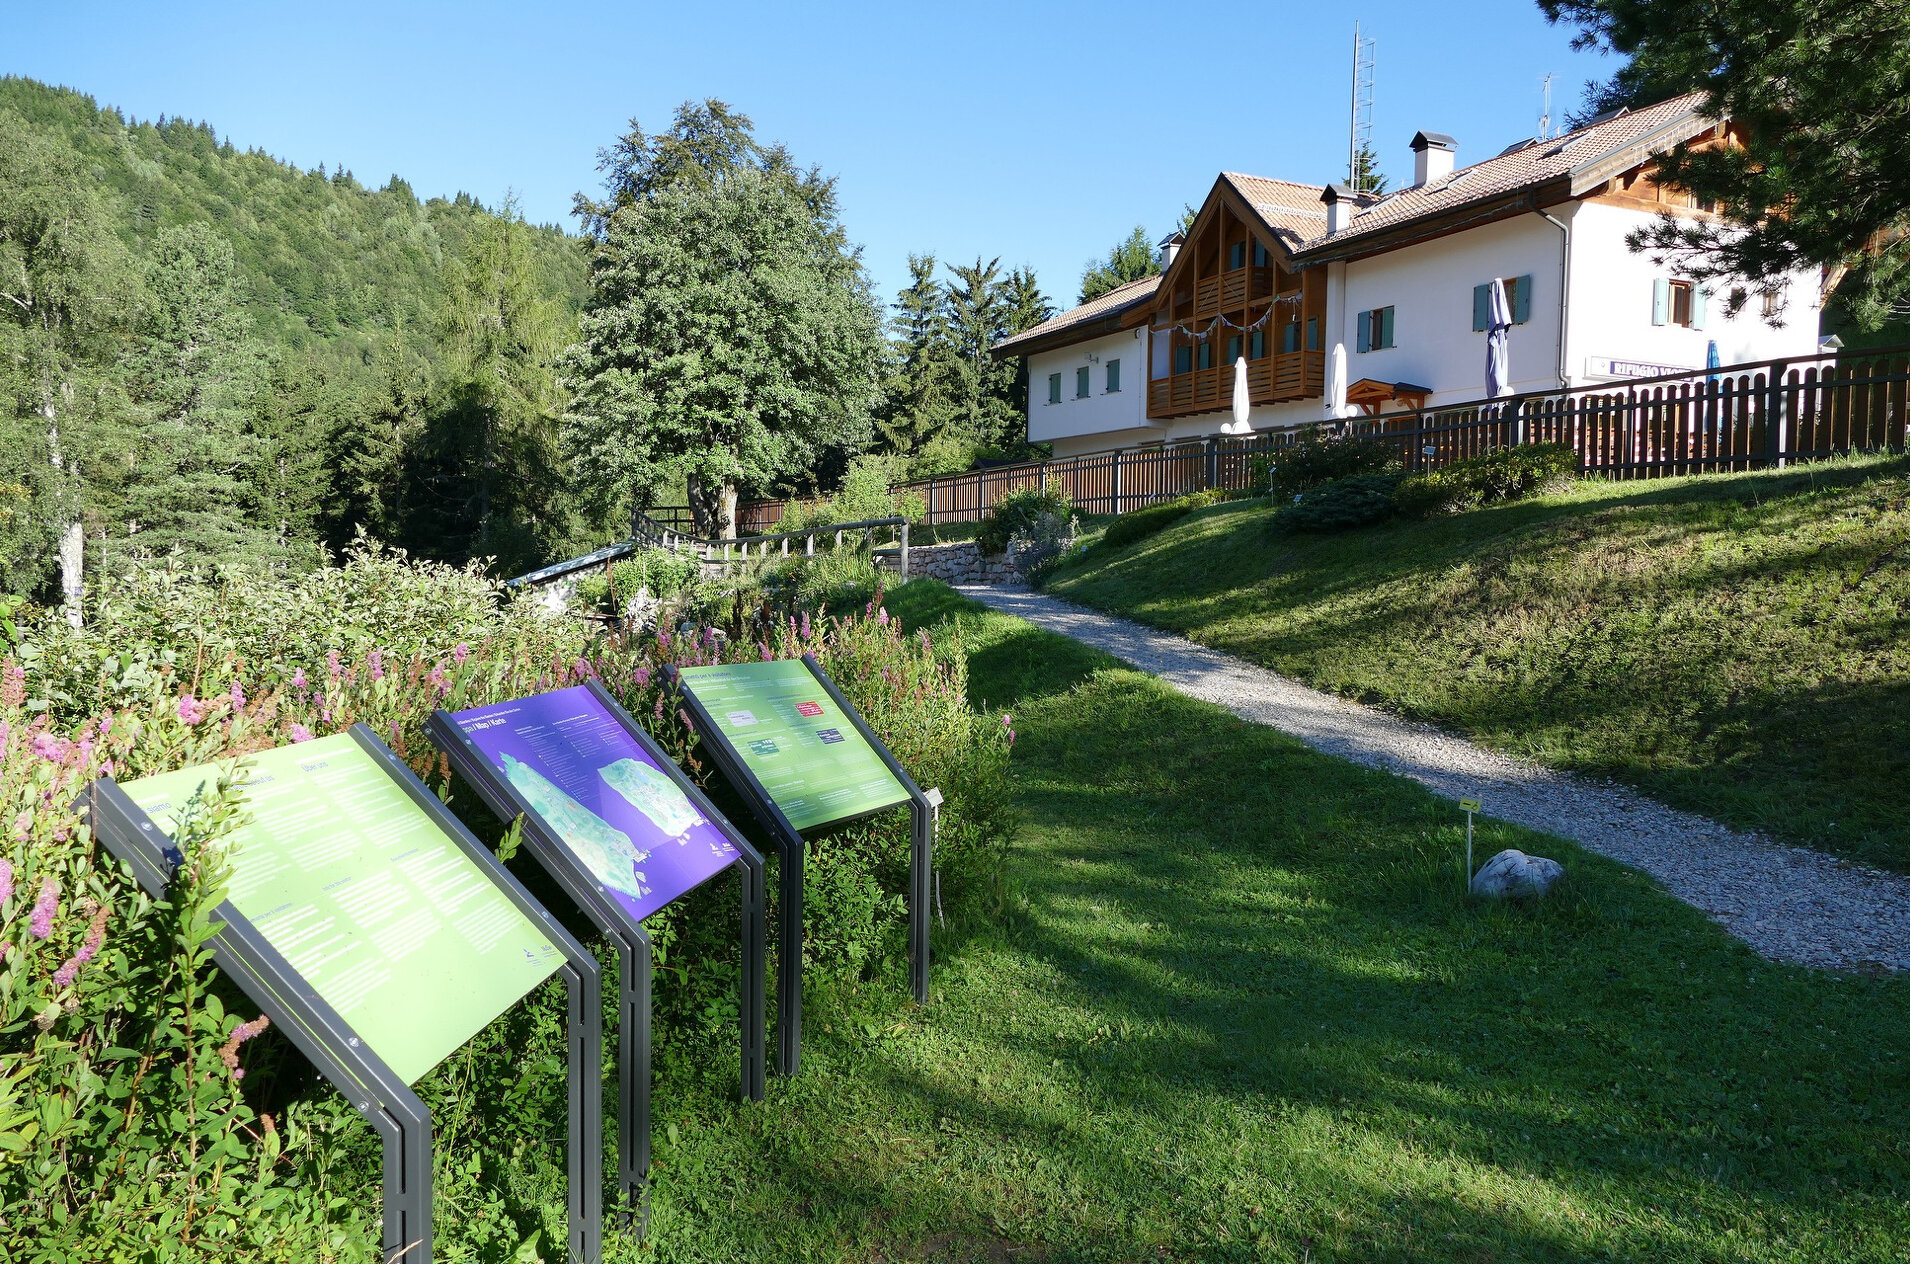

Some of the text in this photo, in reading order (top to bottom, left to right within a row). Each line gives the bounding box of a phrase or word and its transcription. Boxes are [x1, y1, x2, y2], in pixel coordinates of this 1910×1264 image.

[1613, 361, 1659, 377] RIFUGIO
[475, 722, 490, 730] Map
[147, 801, 172, 814] siamo
